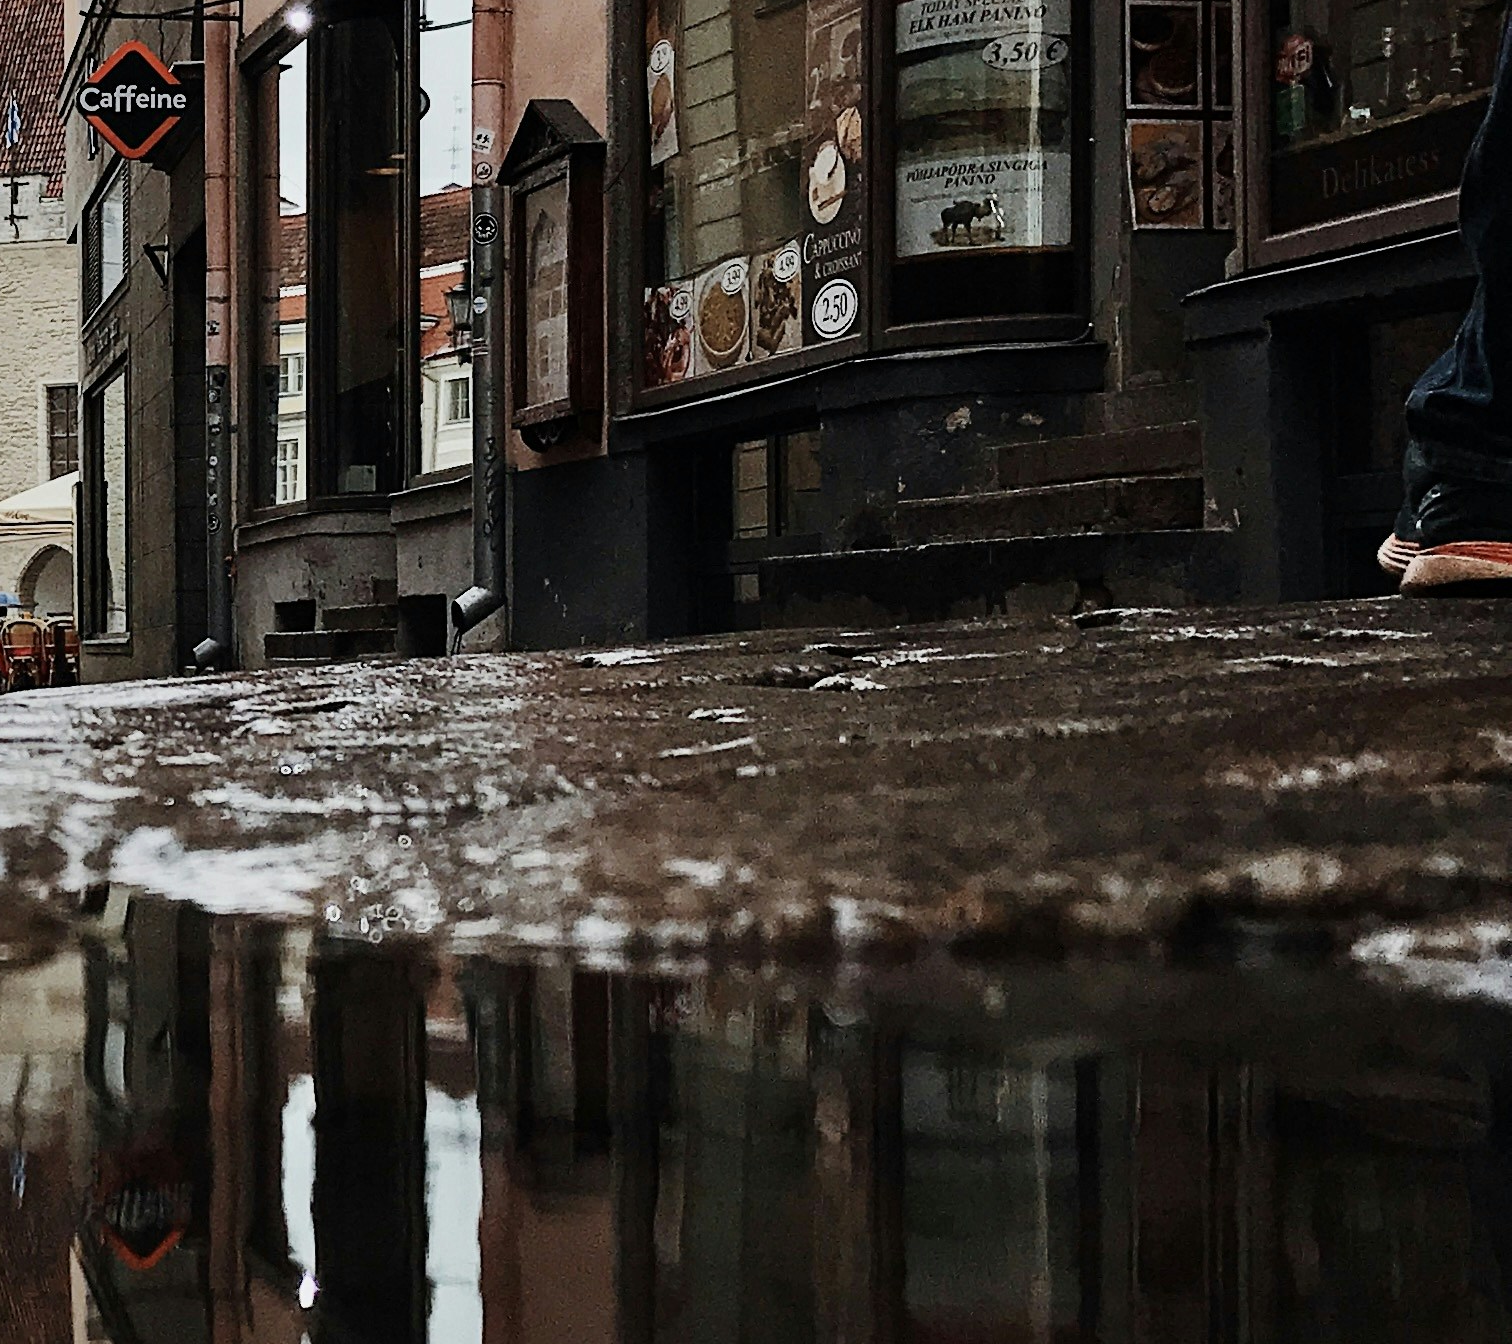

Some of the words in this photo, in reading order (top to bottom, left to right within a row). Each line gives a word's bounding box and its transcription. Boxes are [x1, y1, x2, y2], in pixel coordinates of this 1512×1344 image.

[908, 15, 937, 35] ELK
[938, 10, 977, 28] HAM
[79, 84, 187, 113] Caffeine
[944, 173, 996, 189] PANINO
